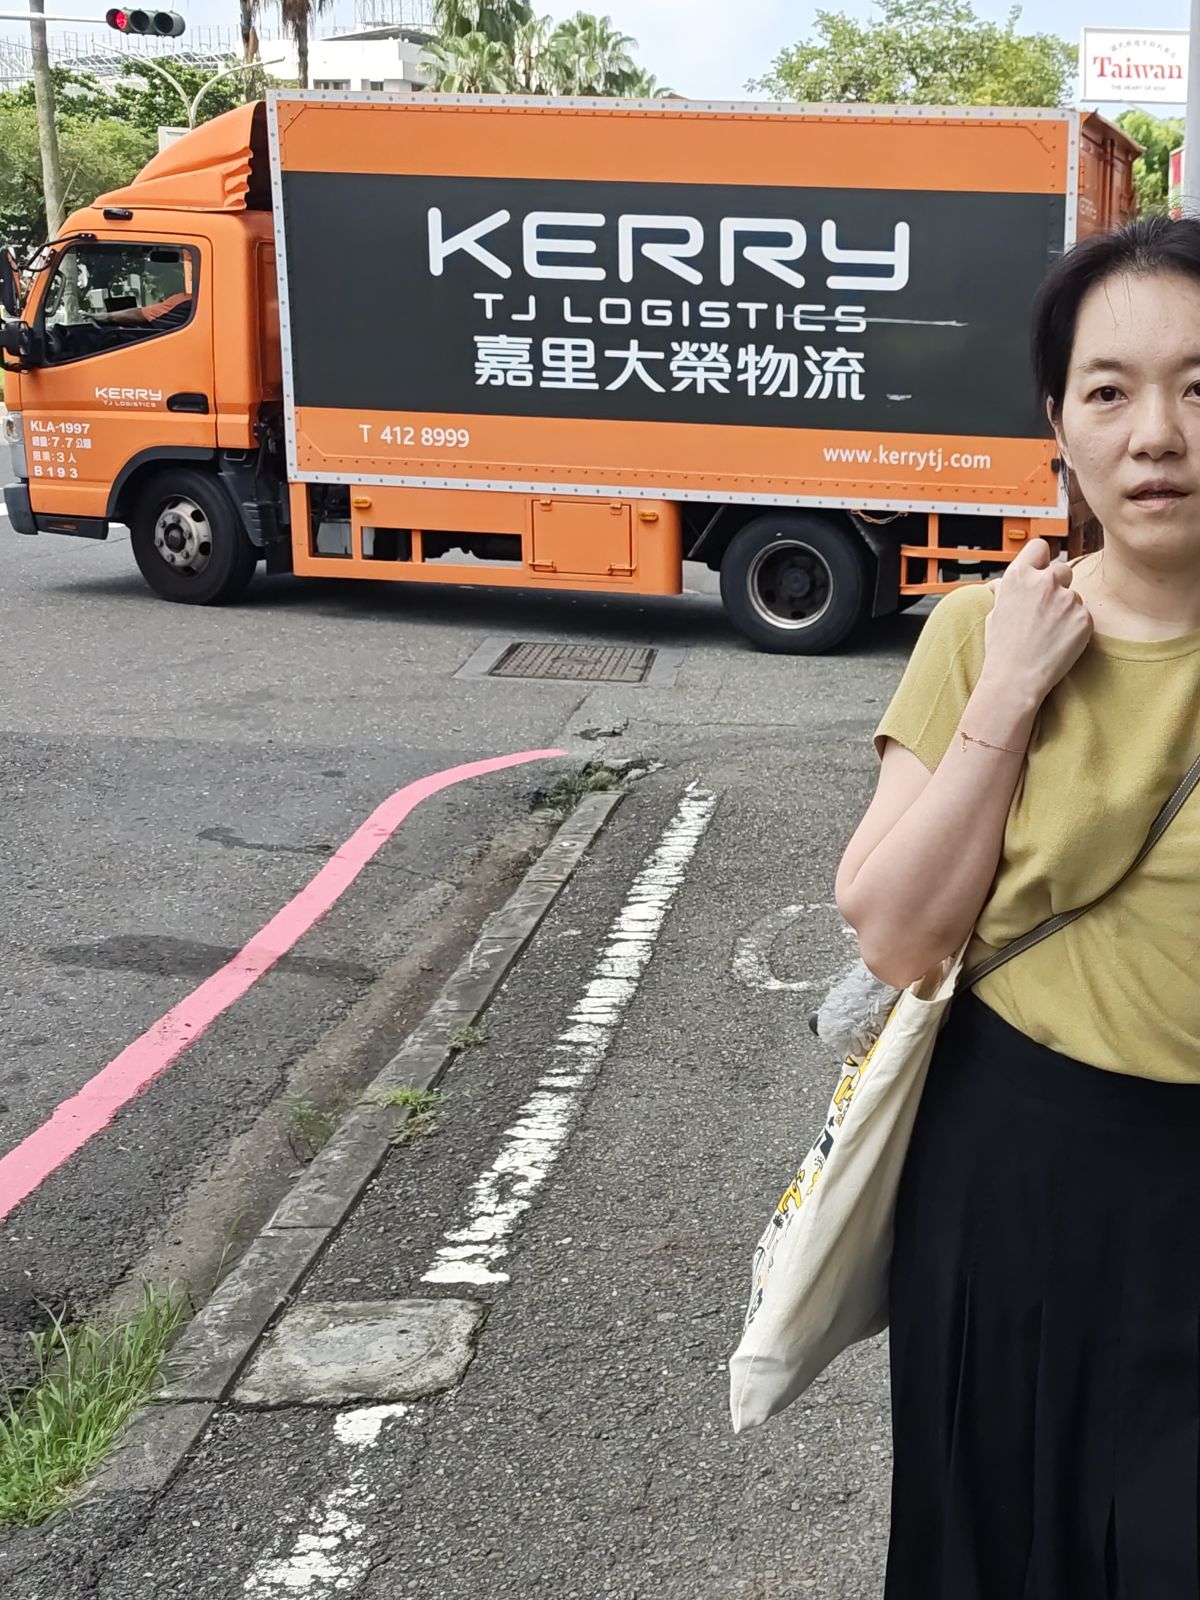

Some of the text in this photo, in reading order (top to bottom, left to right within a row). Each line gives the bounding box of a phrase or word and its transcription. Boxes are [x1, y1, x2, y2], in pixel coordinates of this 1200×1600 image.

[1093, 56, 1183, 79] Taiwan
[426, 205, 911, 292] KERRY
[473, 292, 867, 334] TJ LOGISTICS
[472, 333, 866, 402] 嘉里大榮物流
[95, 387, 162, 400] KERRY
[30, 420, 90, 433] KLA-1997
[358, 424, 470, 448] T 412 8999
[823, 443, 992, 472] www.kerrytj.com
